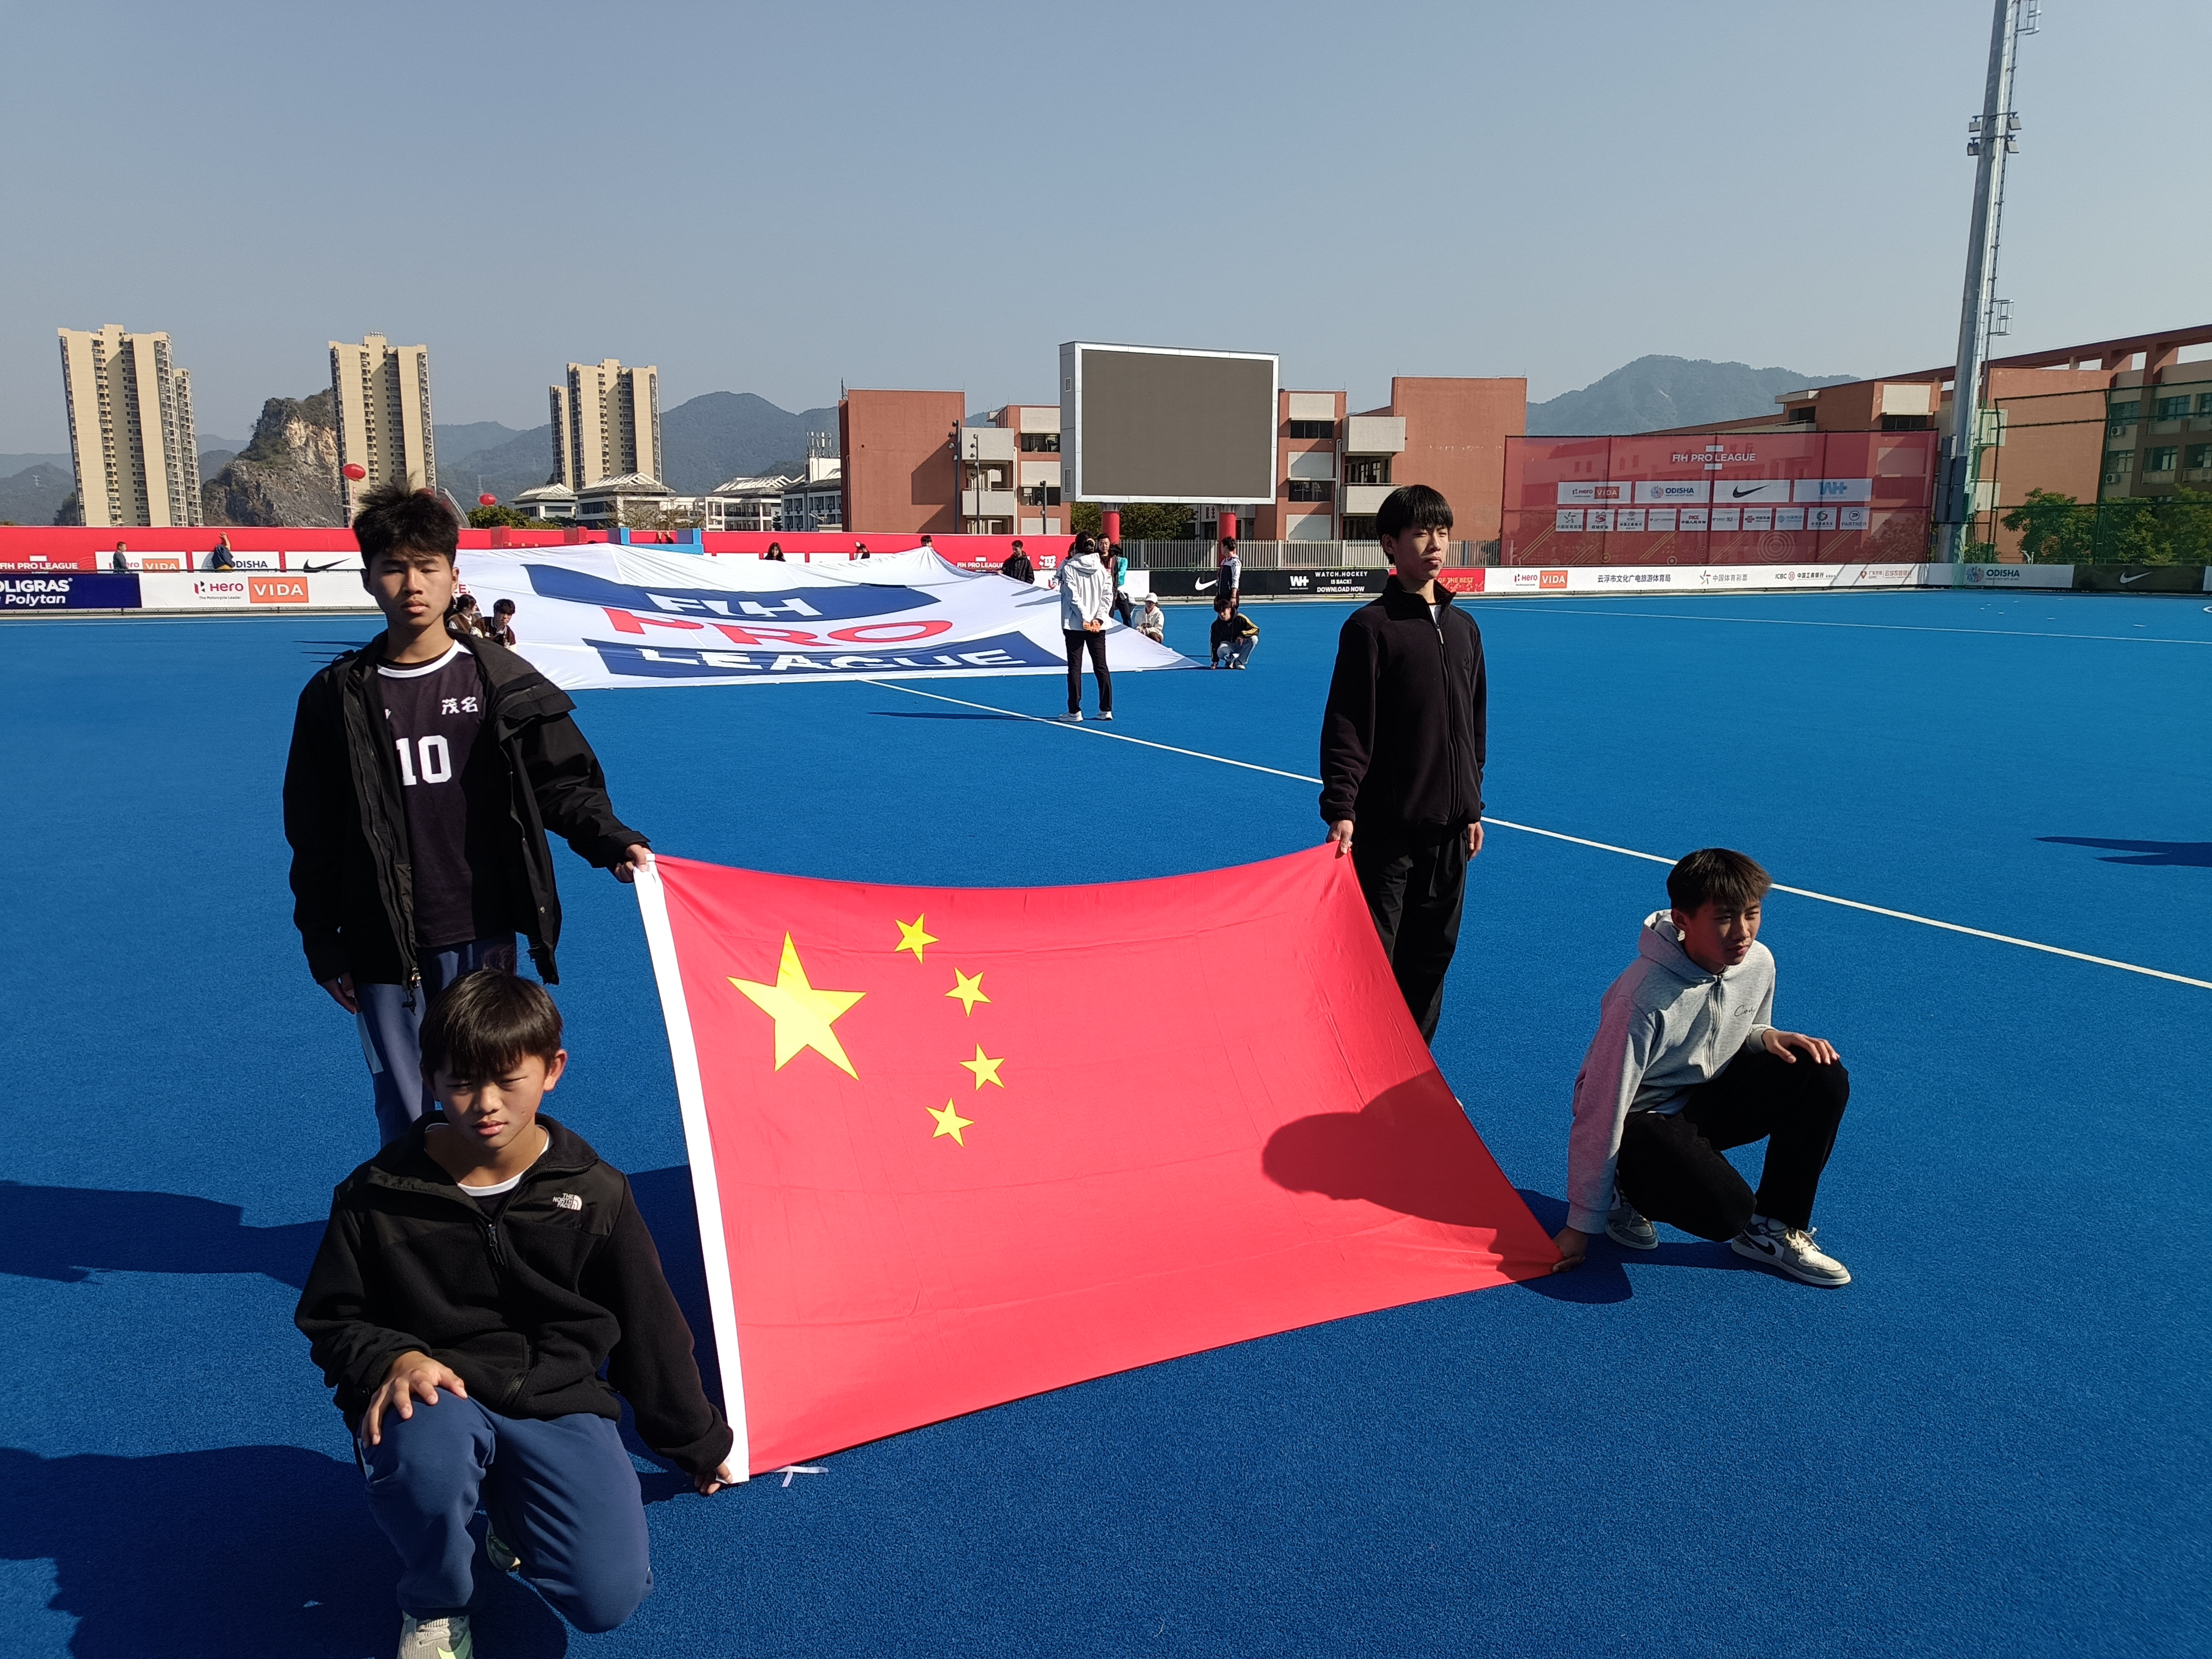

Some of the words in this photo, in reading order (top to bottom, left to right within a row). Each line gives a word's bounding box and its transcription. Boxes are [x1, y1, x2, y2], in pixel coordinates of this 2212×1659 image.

[1691, 453, 1713, 462] PRO
[1542, 575, 1565, 584] VIDA
[1598, 574, 1671, 583] 云浮市文化广电旅游体育局
[210, 583, 244, 592] Hero
[253, 584, 304, 596] VIDA
[5, 594, 66, 607] Polytan
[601, 607, 953, 647] PRO
[635, 648, 1027, 671] LEAGUE
[442, 696, 478, 714] 茂名
[395, 735, 452, 786] 10
[552, 1196, 573, 1205] NORTH
